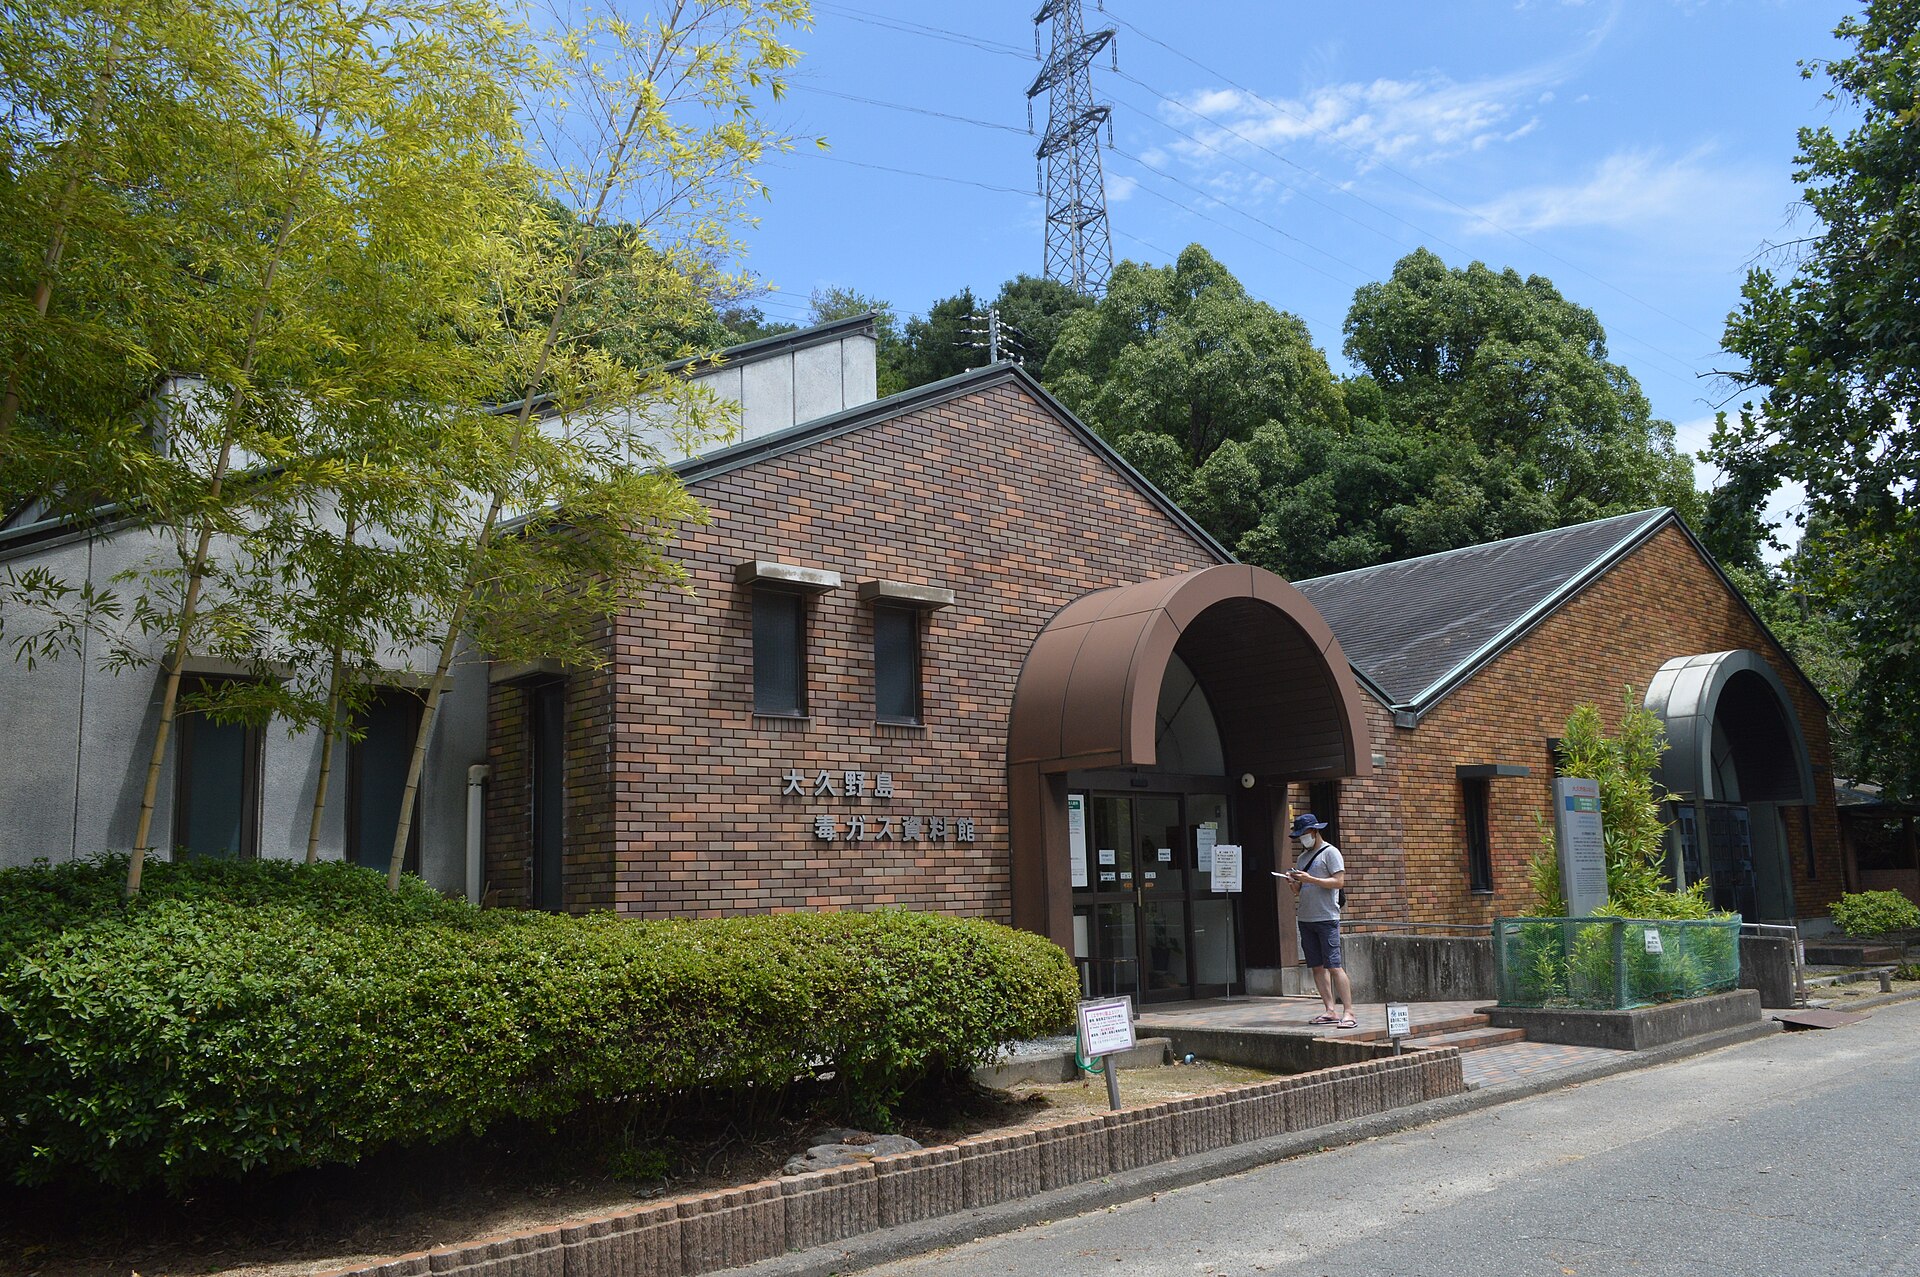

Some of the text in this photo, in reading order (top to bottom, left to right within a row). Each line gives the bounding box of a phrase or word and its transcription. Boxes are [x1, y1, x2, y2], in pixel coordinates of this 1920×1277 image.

[782, 769, 894, 799] 大久野島
[815, 814, 975, 842] 毒ガス資料館
